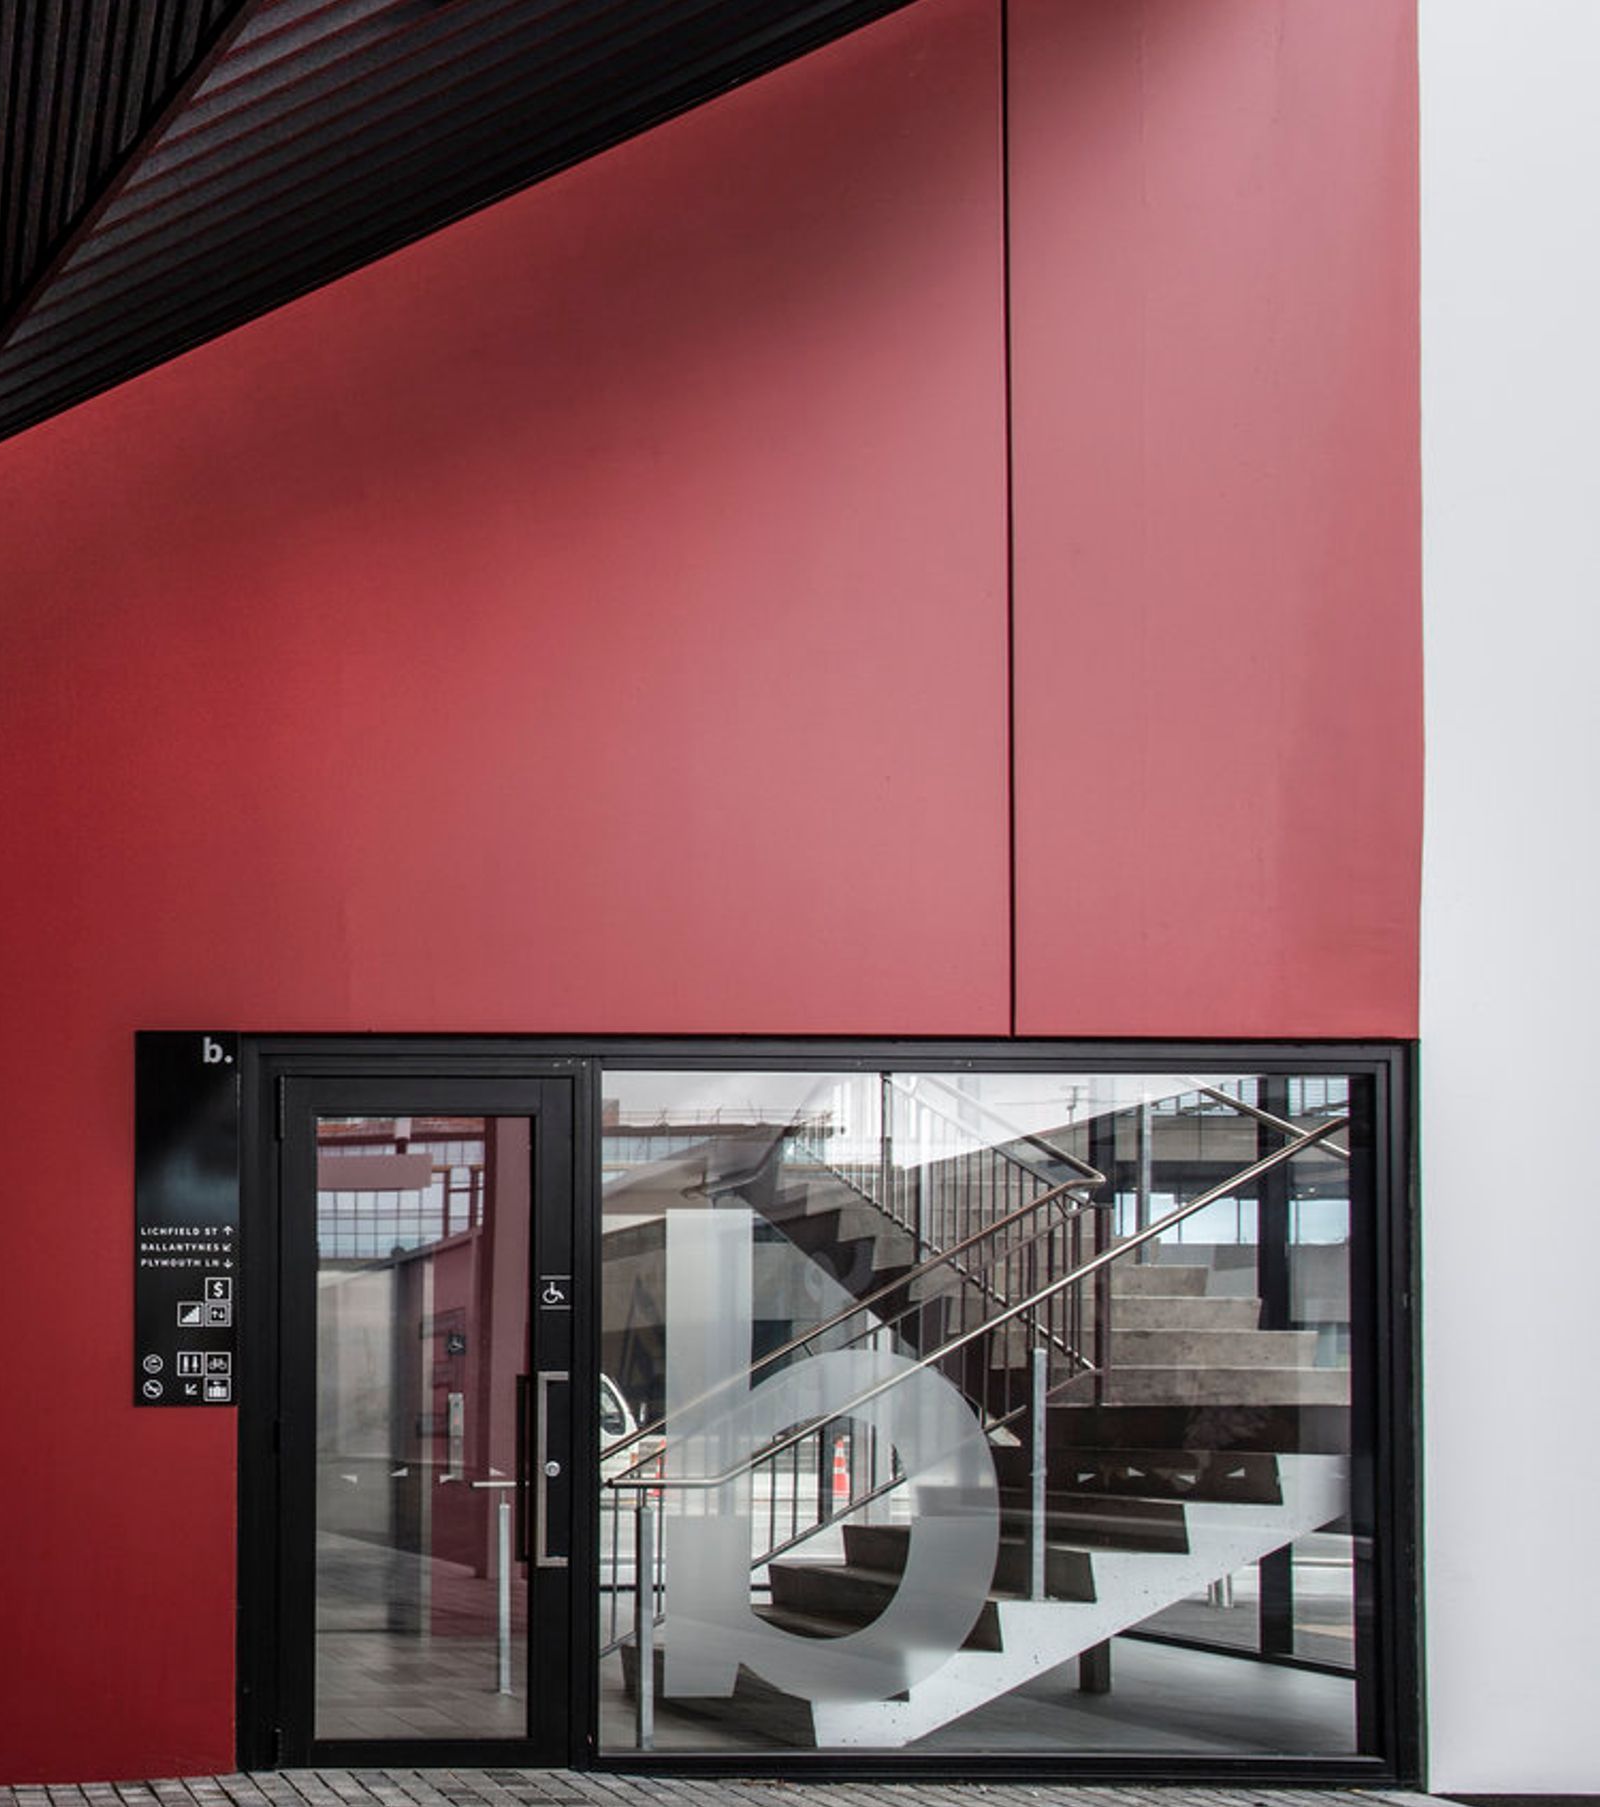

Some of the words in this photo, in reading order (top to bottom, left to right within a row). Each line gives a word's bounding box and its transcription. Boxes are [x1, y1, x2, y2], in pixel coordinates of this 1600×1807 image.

[203, 1036, 233, 1063] b.
[141, 1227, 200, 1236] LICHFIELD
[204, 1227, 218, 1236] ST
[141, 1243, 219, 1252] BALLANTYNES
